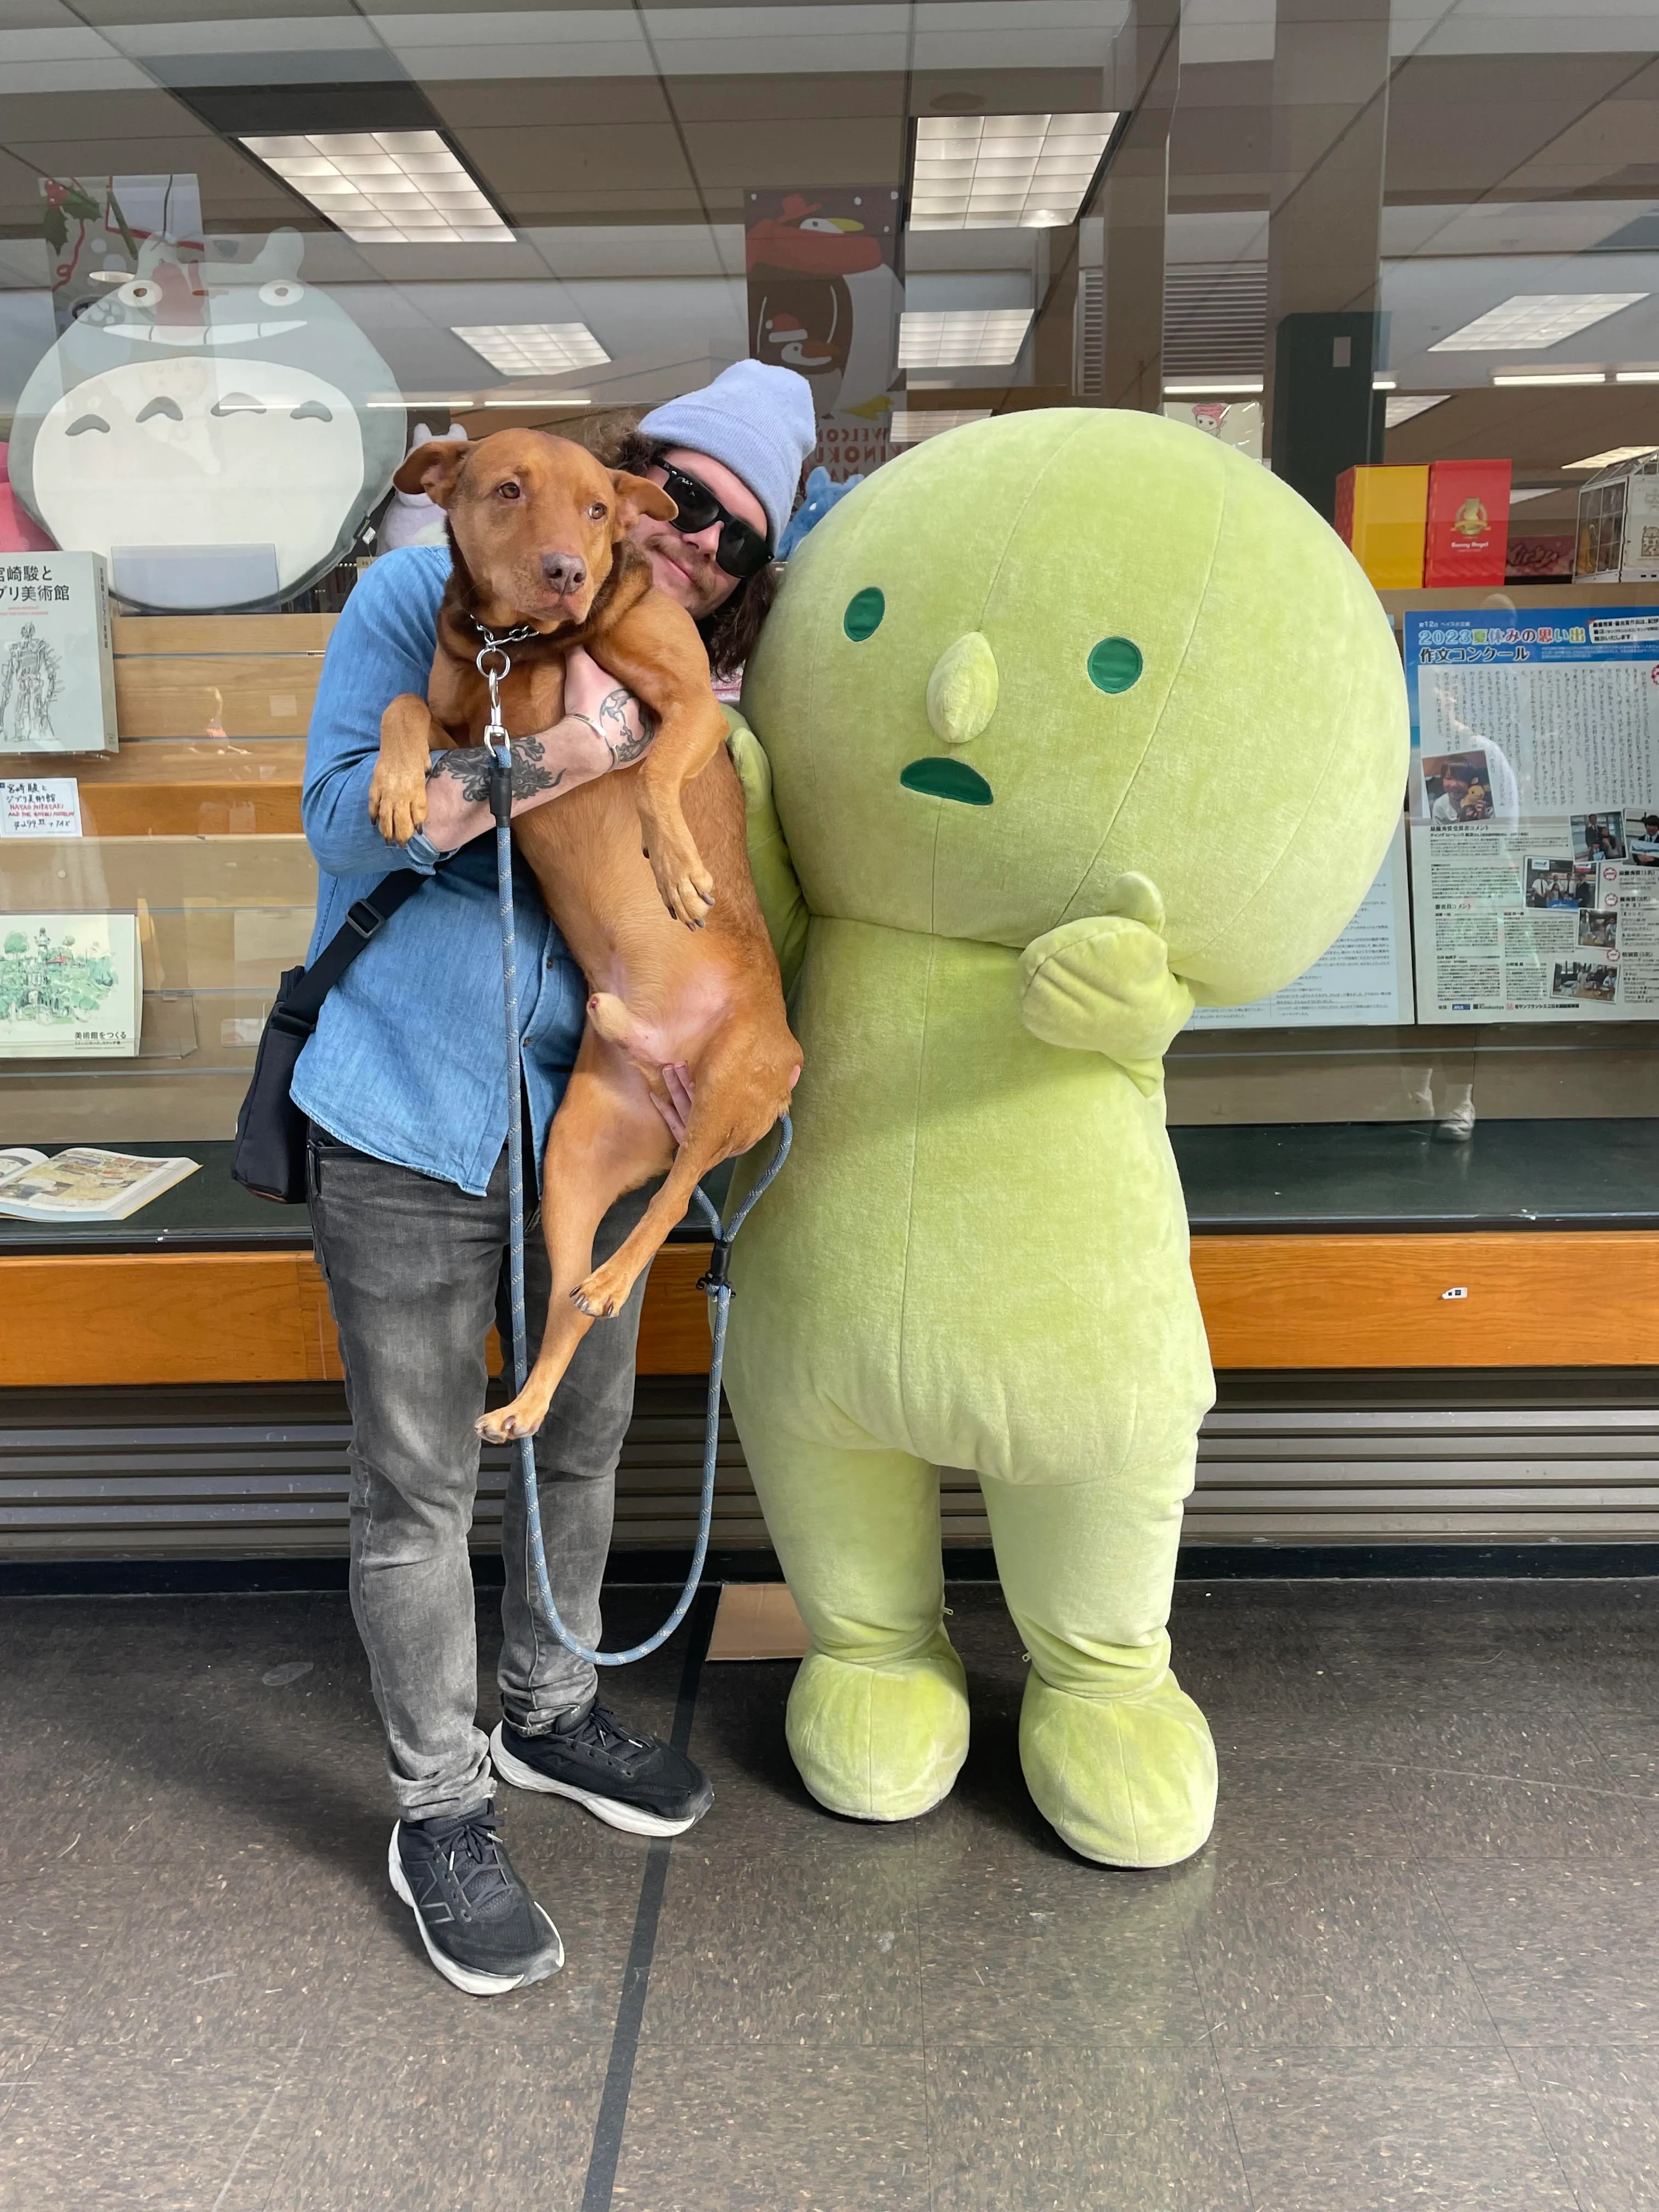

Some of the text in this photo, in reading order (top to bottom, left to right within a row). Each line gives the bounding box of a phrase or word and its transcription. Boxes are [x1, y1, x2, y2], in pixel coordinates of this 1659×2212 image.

[1418, 627, 1586, 646] 2023夏休みの思い出
[1419, 646, 1530, 663] 作文コンクール
[75, 1031, 127, 1040] 美術館をつくる
